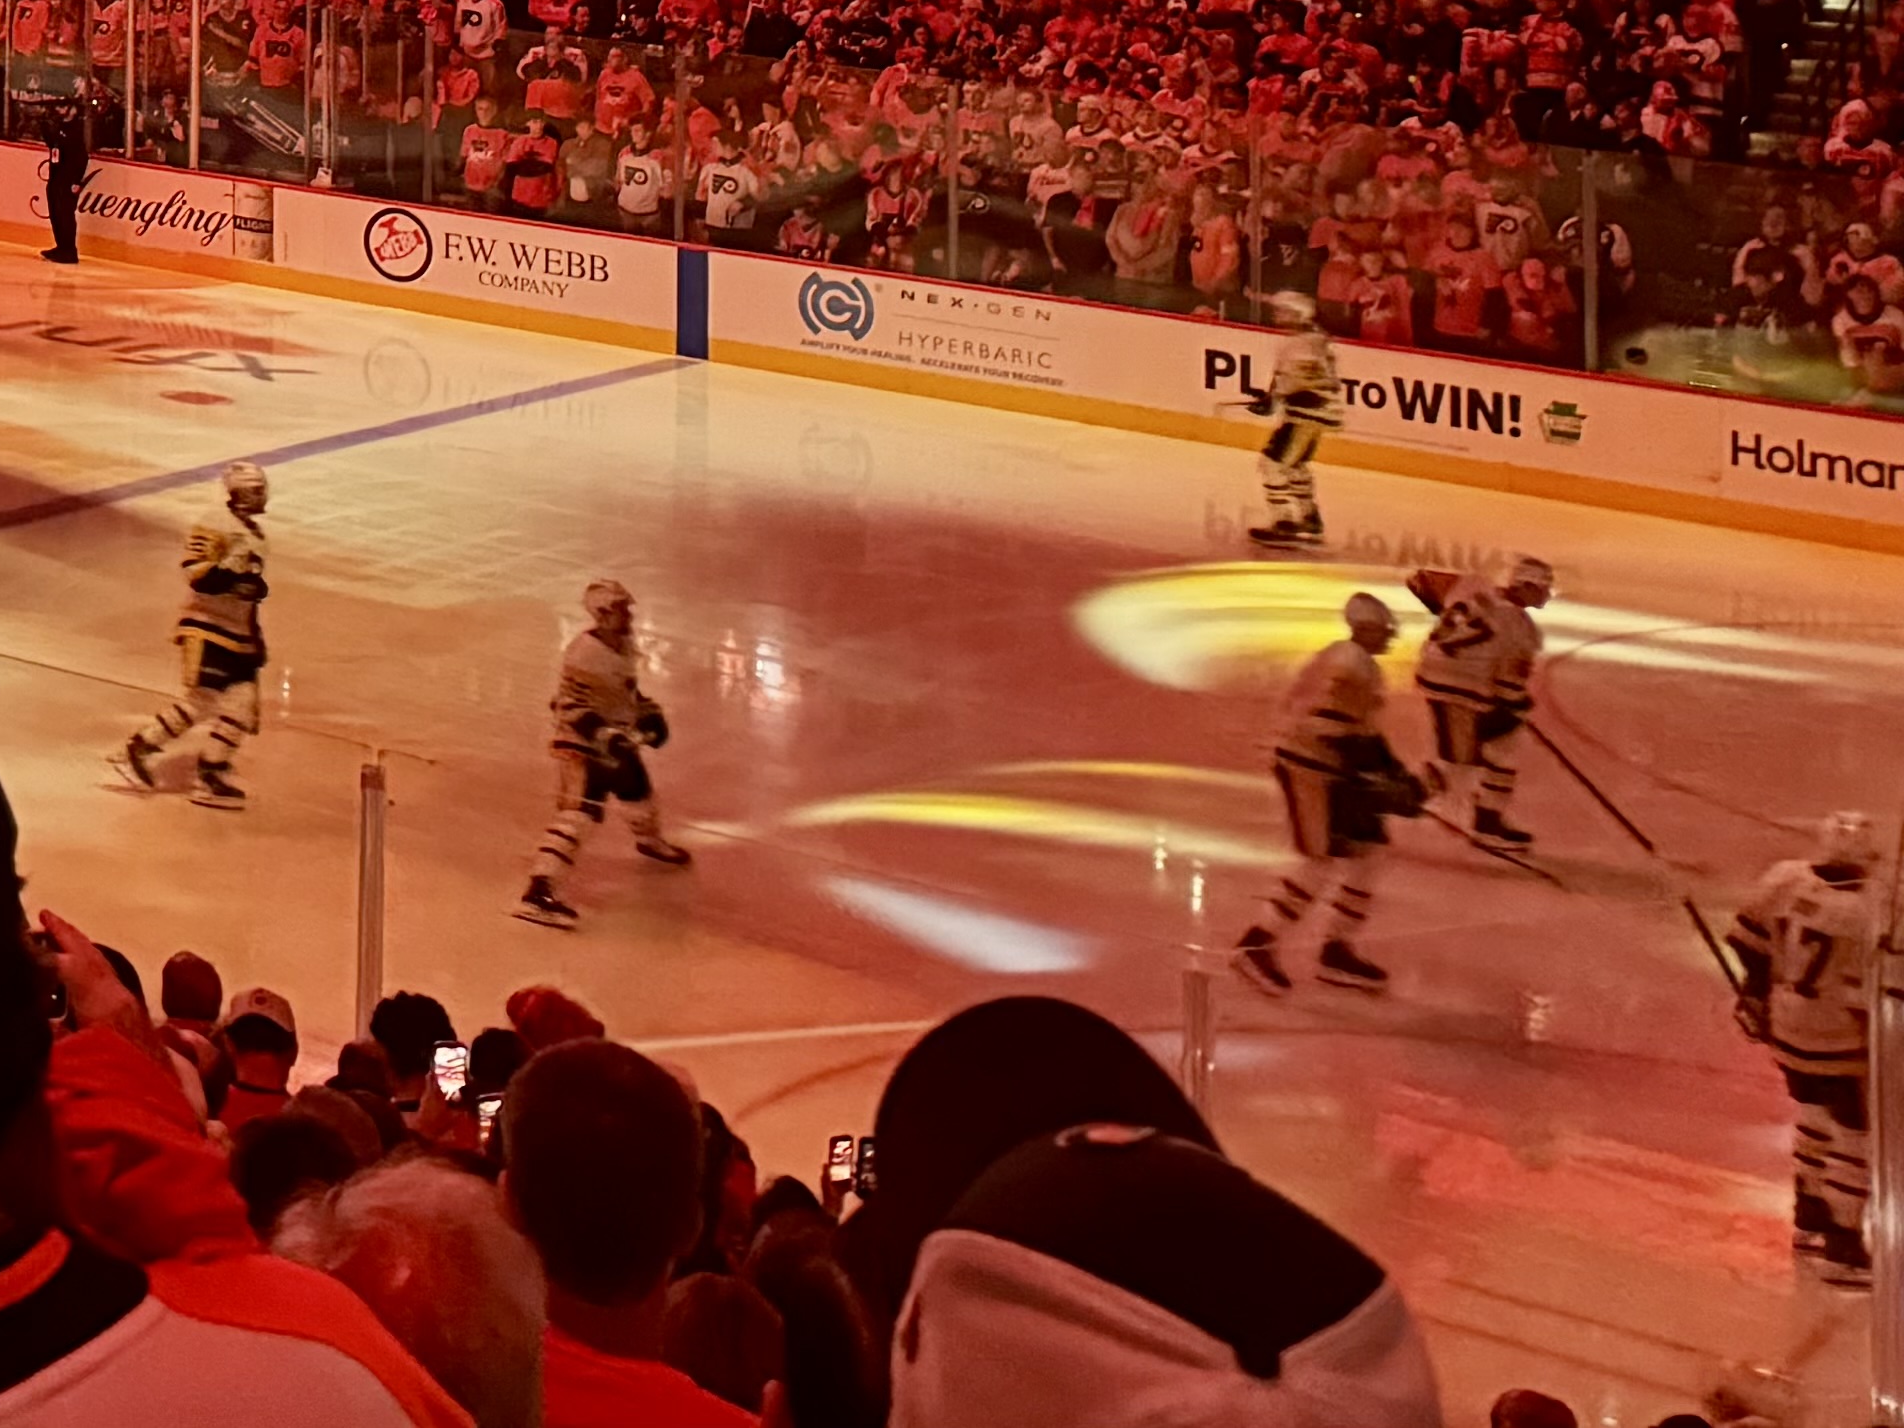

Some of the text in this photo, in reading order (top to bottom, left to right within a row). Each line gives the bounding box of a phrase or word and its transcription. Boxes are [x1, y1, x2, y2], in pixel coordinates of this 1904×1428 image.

[443, 232, 610, 283] F.W. WEBB
[478, 270, 570, 298] COMPANY
[898, 330, 1053, 369] HYPERBARIC
[1204, 348, 1266, 398] PL
[1341, 378, 1387, 409] TO
[1392, 376, 1522, 438] WIN!
